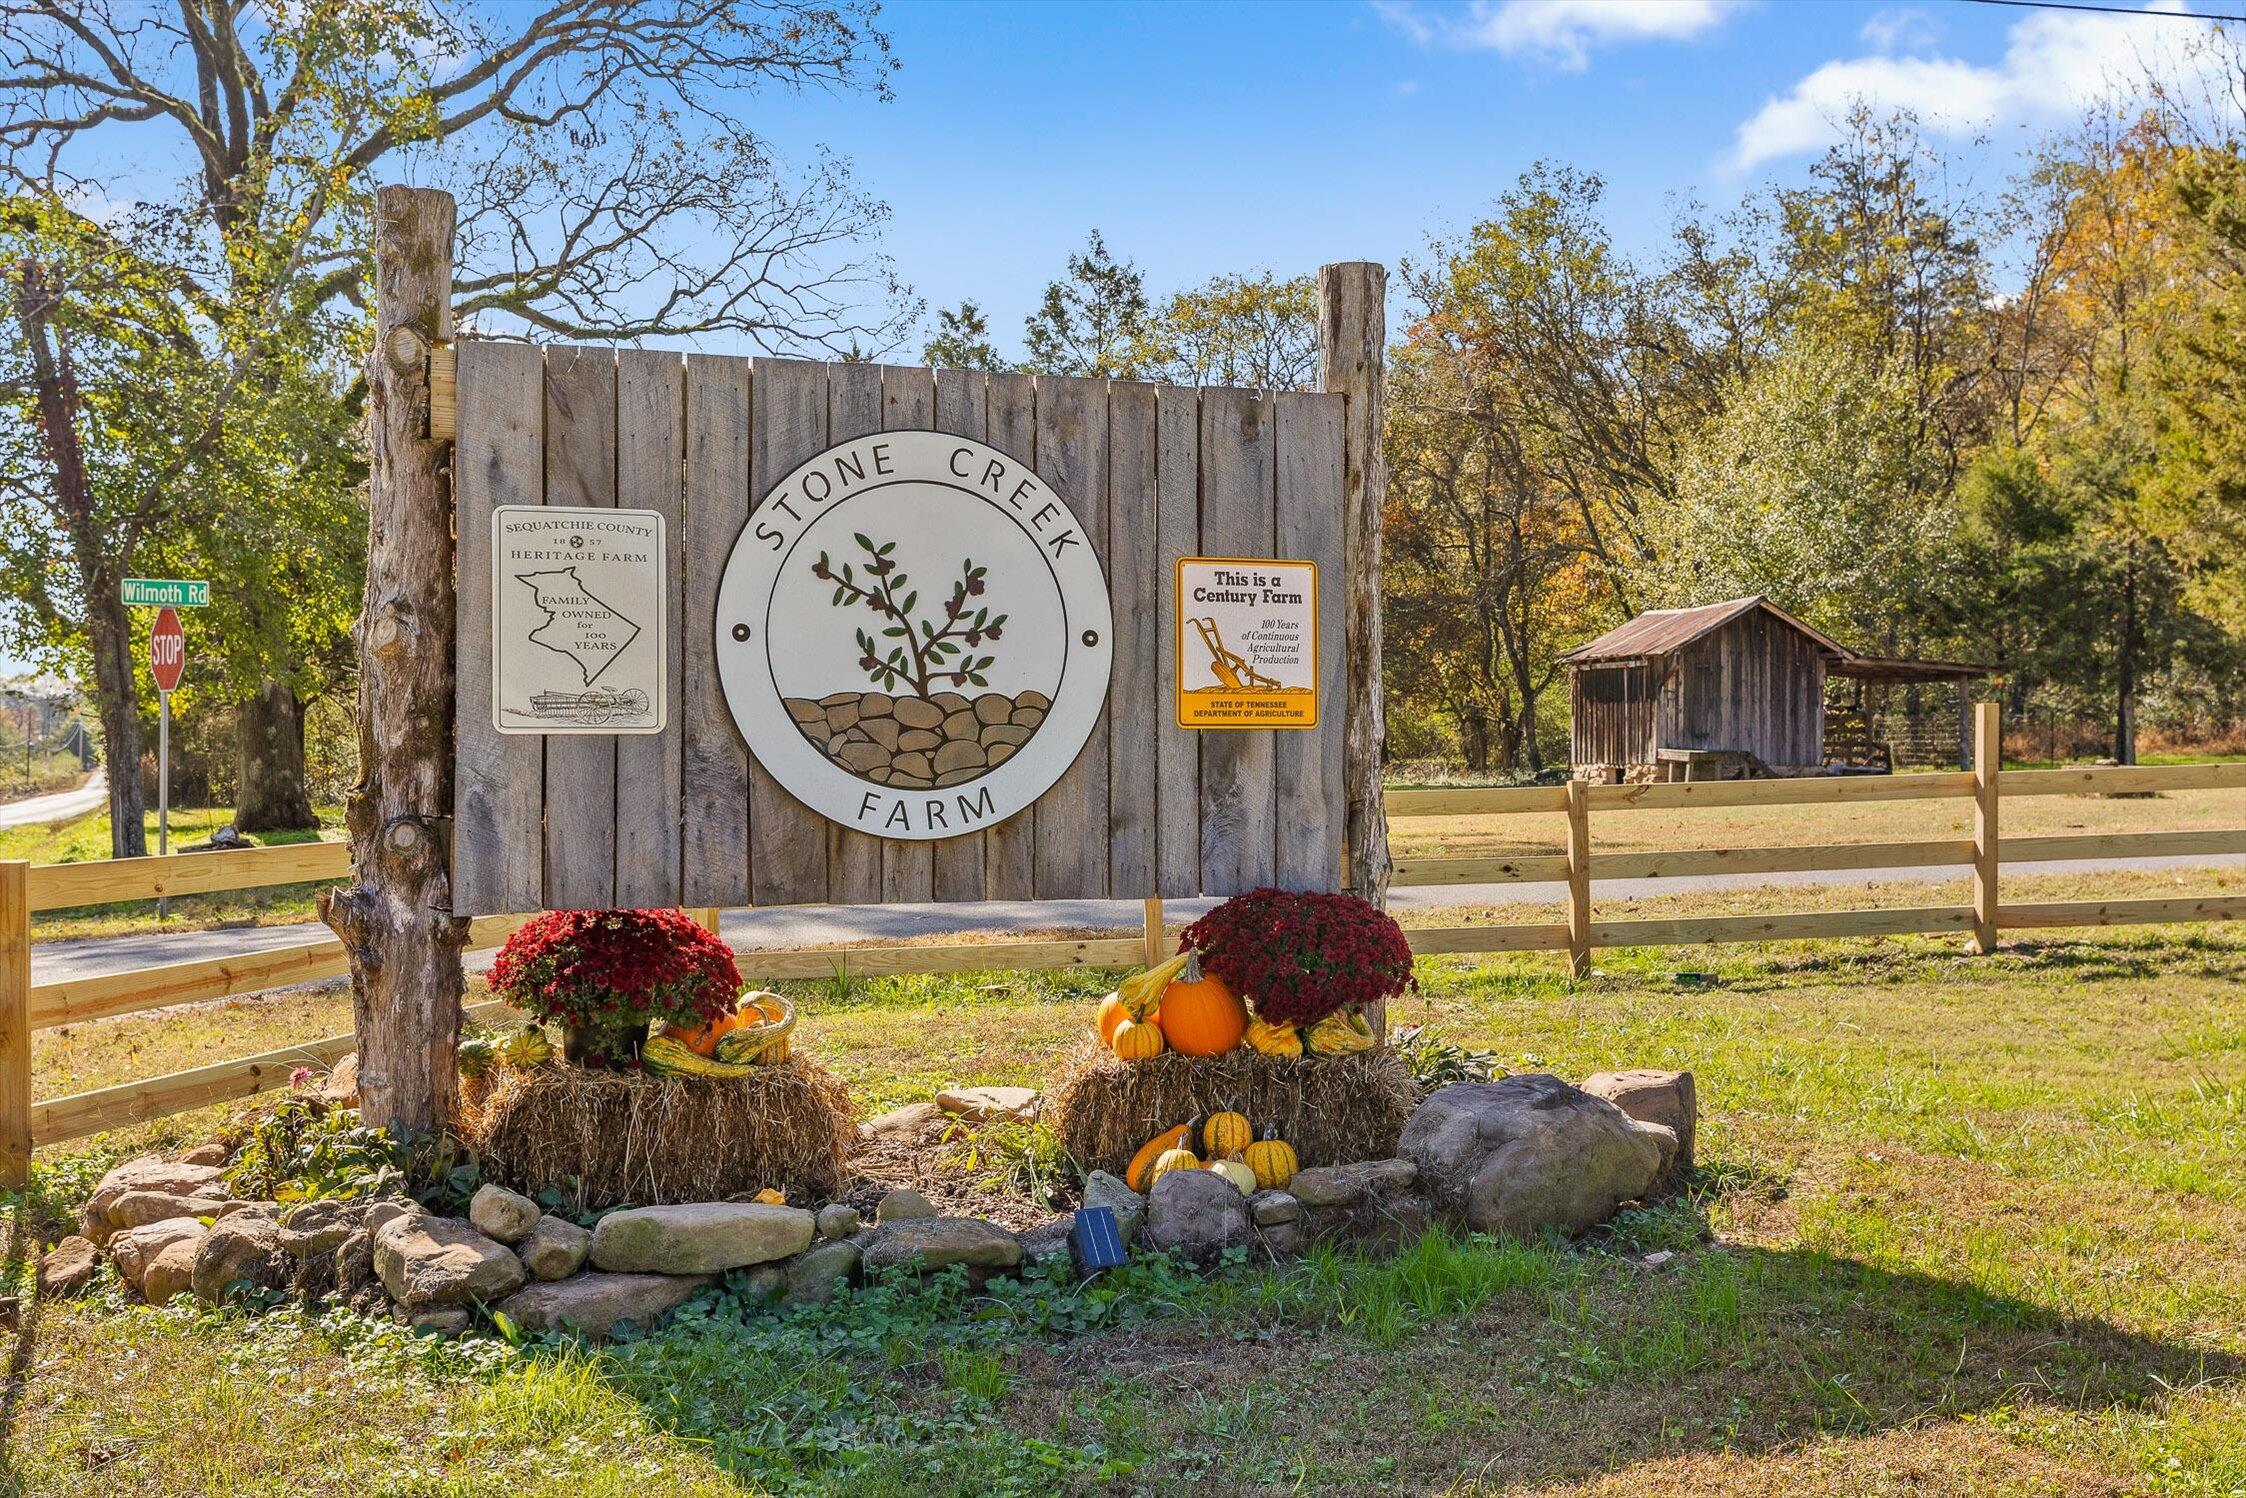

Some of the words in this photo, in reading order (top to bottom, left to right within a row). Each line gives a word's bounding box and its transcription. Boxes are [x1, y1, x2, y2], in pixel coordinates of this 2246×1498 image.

[755, 444, 894, 551] STONE
[949, 448, 1080, 559] CREEK
[506, 520, 594, 533] SEQUATCHIE
[597, 522, 652, 537] COUNTY
[511, 551, 596, 561] HERITAGE
[602, 552, 648, 562] FARM
[1214, 572, 1248, 587] This
[1253, 573, 1266, 587] is
[1271, 578, 1281, 587] a
[124, 583, 182, 602] Wilmoth
[188, 585, 207, 604] Rd
[1193, 588, 1257, 606] Century
[1262, 590, 1302, 604] Farm
[542, 596, 590, 605] FAMILY
[562, 611, 612, 619] OWNED
[1262, 620, 1276, 629] 100
[1276, 620, 1299, 630] Years
[1242, 631, 1251, 640] of
[1251, 632, 1299, 641] Continuous
[153, 635, 181, 665] STOP
[574, 642, 617, 650] YEARS
[1247, 643, 1300, 653] Agricultural
[1252, 655, 1299, 664] Production
[857, 786, 996, 831] FARM
